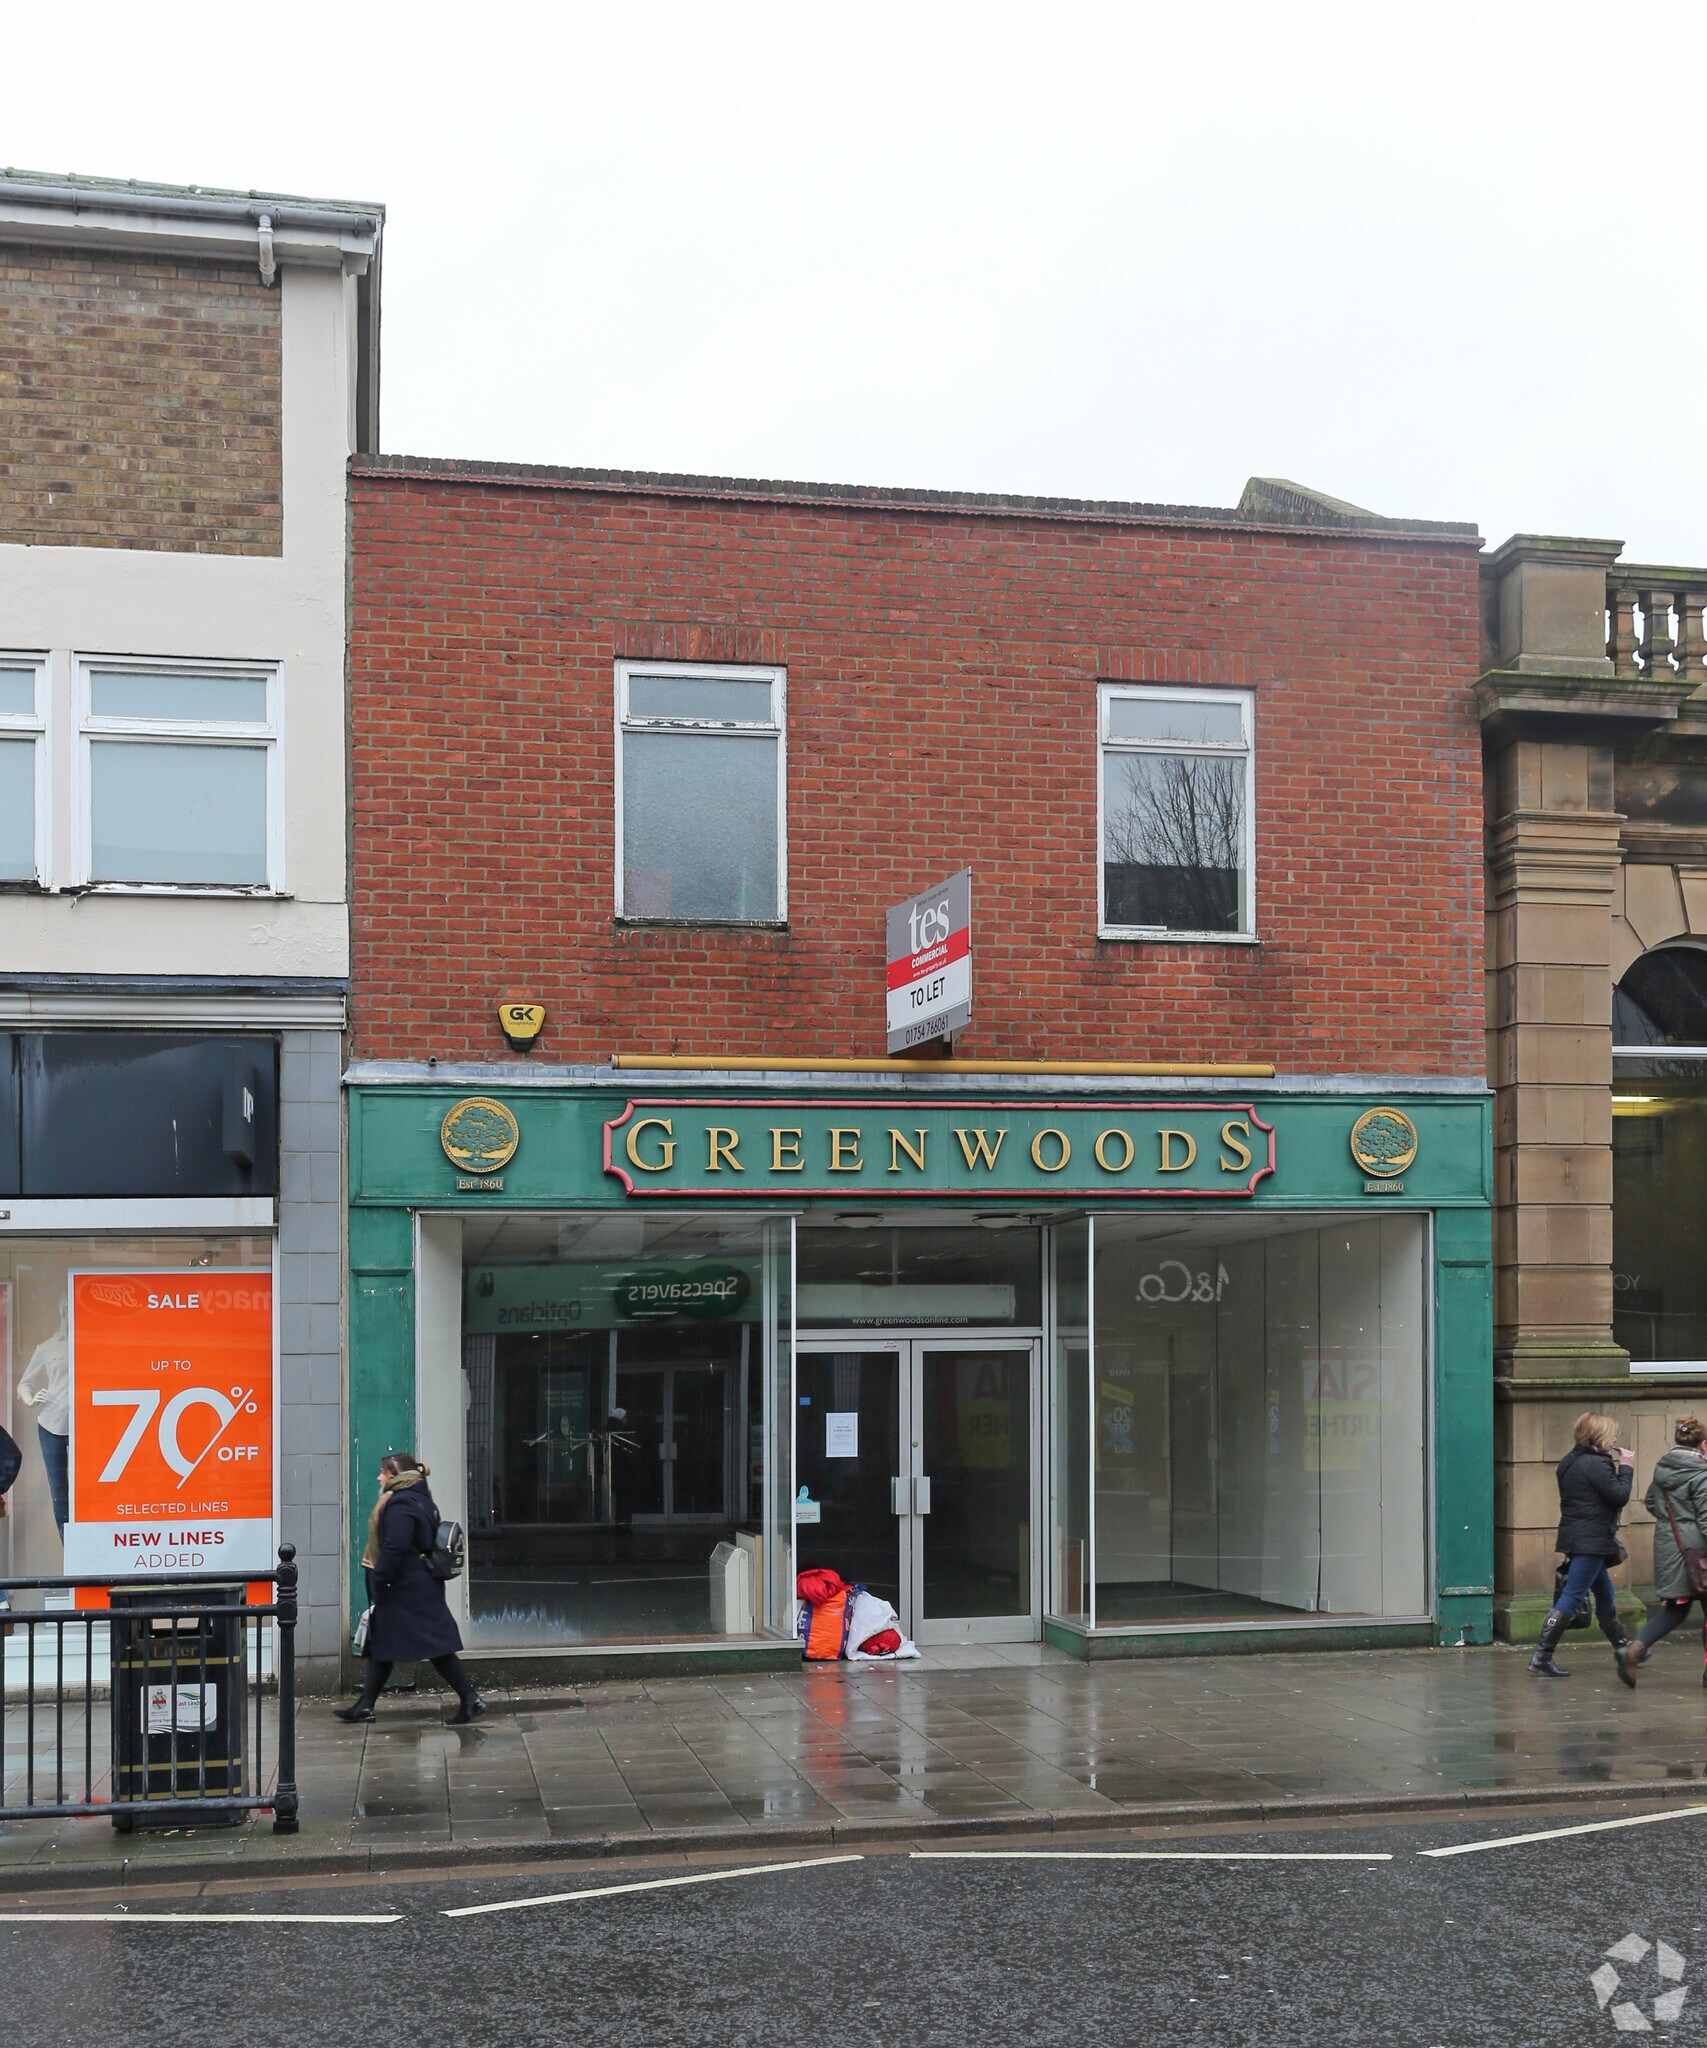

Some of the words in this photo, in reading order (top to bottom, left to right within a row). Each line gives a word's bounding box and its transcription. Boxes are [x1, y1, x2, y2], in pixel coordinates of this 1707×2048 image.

[908, 898, 950, 955] tes
[911, 944, 949, 969] COMMERCIAL
[910, 988, 924, 1009] TO
[926, 976, 945, 1002] LET
[510, 1007, 535, 1021] GK
[905, 1024, 925, 1044] 01754
[926, 1014, 949, 1037] 766061
[626, 1119, 1253, 1172] GREENWOODS
[480, 1178, 503, 1190] 1860
[1384, 1182, 1404, 1192] 1860
[147, 1293, 200, 1309] SALE
[852, 1316, 968, 1327] www.greenwoodsonline.com
[151, 1360, 169, 1371] UP
[173, 1360, 191, 1371] TO
[217, 1446, 259, 1462] OFF
[116, 1503, 186, 1515] SELECTED
[190, 1501, 229, 1513] LINES
[114, 1532, 162, 1547] NEW
[168, 1531, 225, 1545] LINES
[134, 1553, 205, 1568] ADDED
